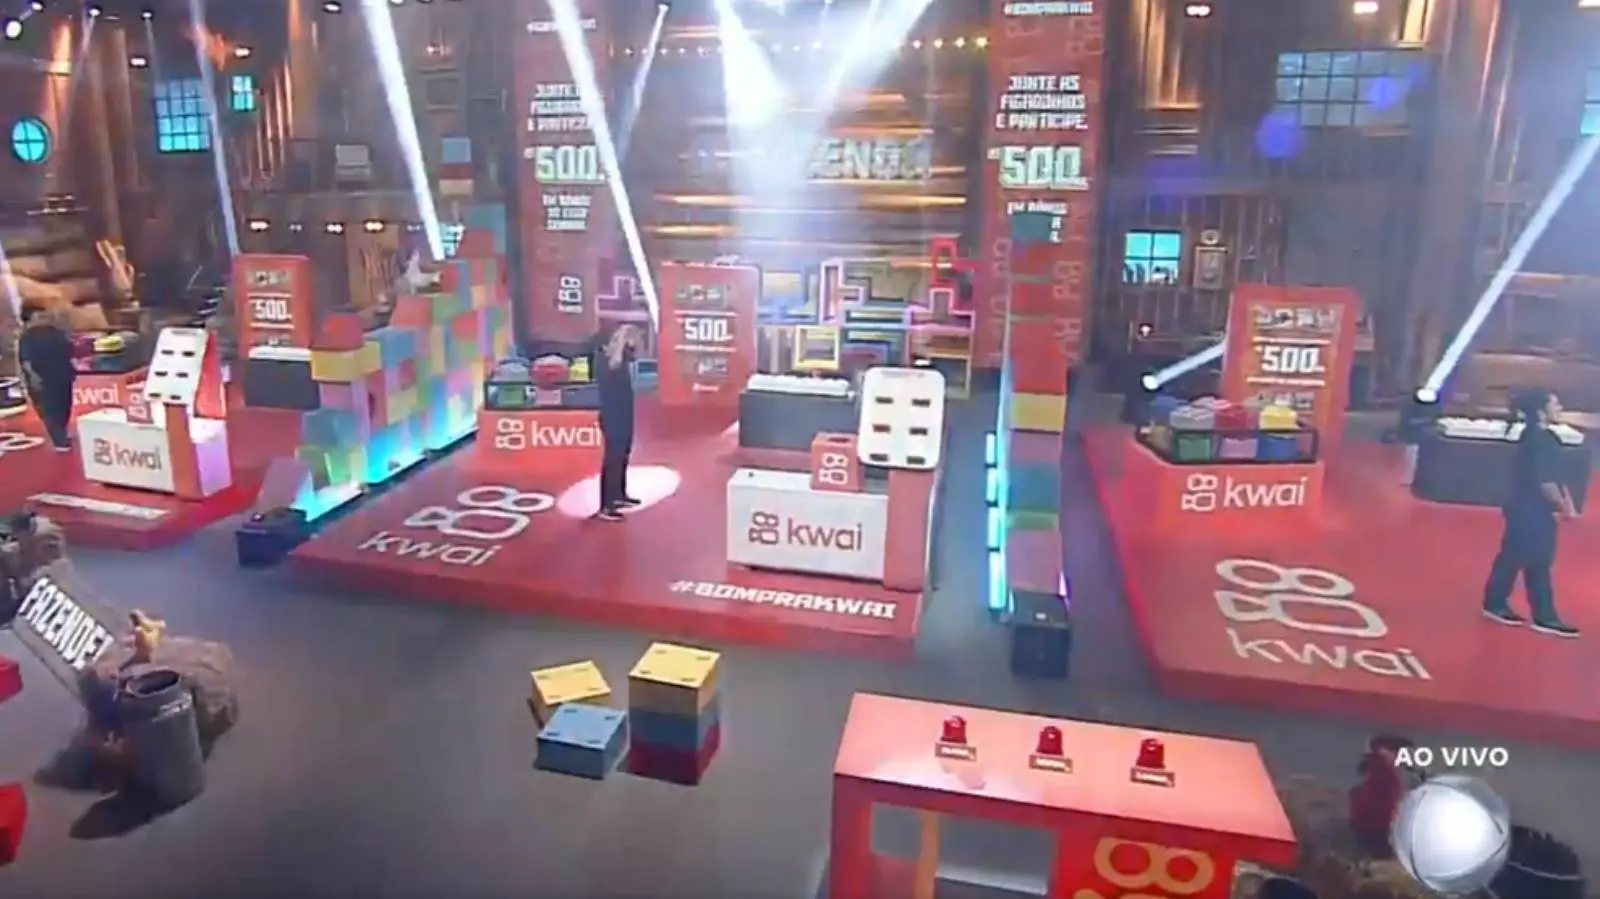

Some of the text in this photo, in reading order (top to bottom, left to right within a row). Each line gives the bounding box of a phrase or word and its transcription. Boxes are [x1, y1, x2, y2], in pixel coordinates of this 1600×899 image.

[531, 421, 601, 447] kwai
[1223, 476, 1308, 507] kwai
[358, 531, 502, 566] kwai
[786, 518, 863, 551] kwai
[669, 580, 897, 620] #BOMPRAKWAI
[1226, 627, 1432, 680] kwai
